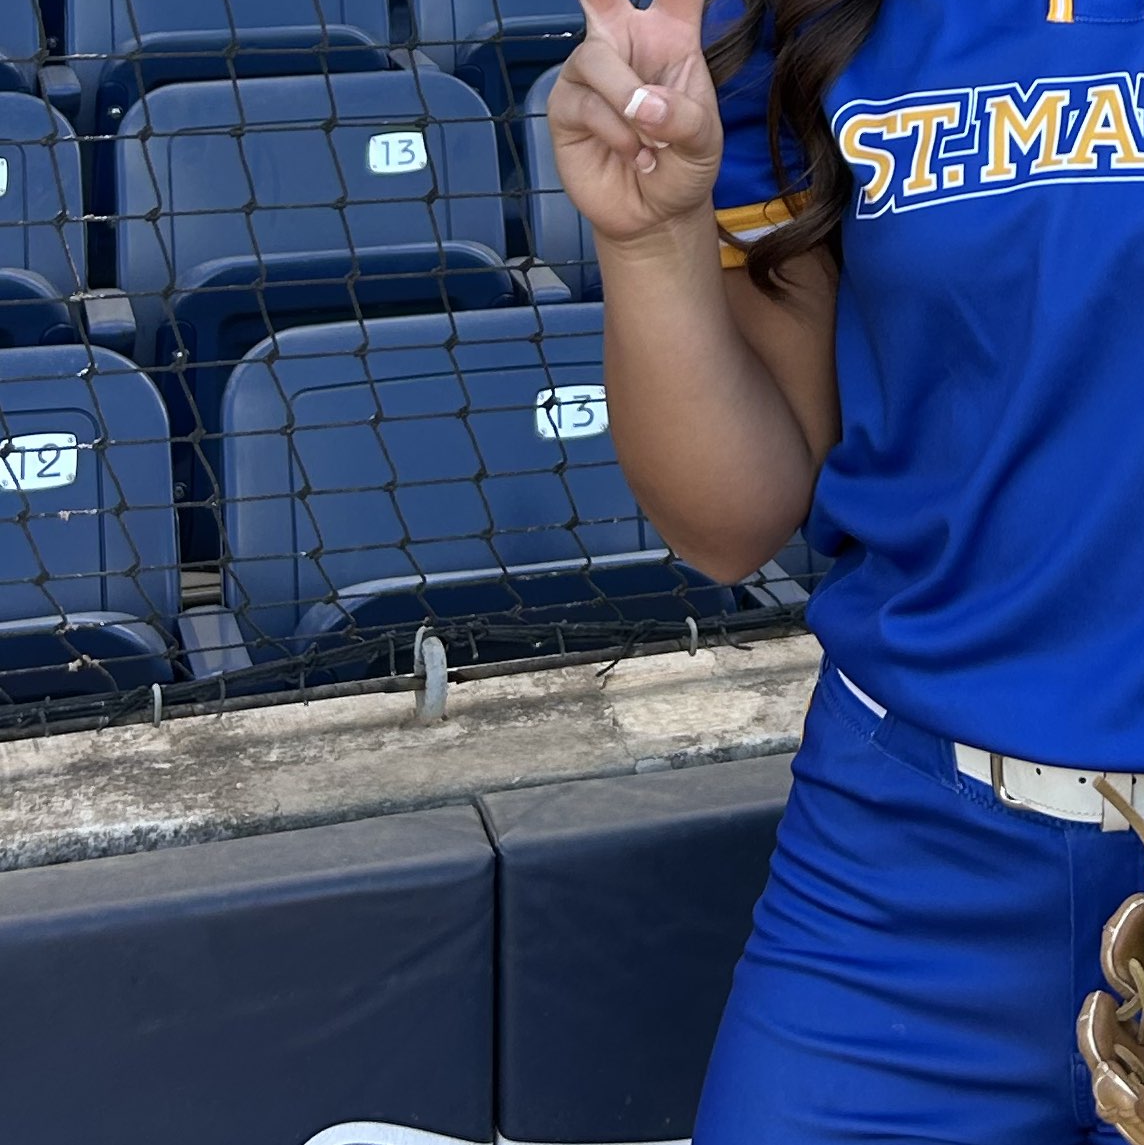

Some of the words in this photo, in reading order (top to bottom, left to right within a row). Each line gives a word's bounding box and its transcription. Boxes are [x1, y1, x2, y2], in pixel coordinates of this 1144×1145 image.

[381, 139, 415, 166] 13
[554, 394, 594, 429] 13
[15, 443, 61, 480] 12
